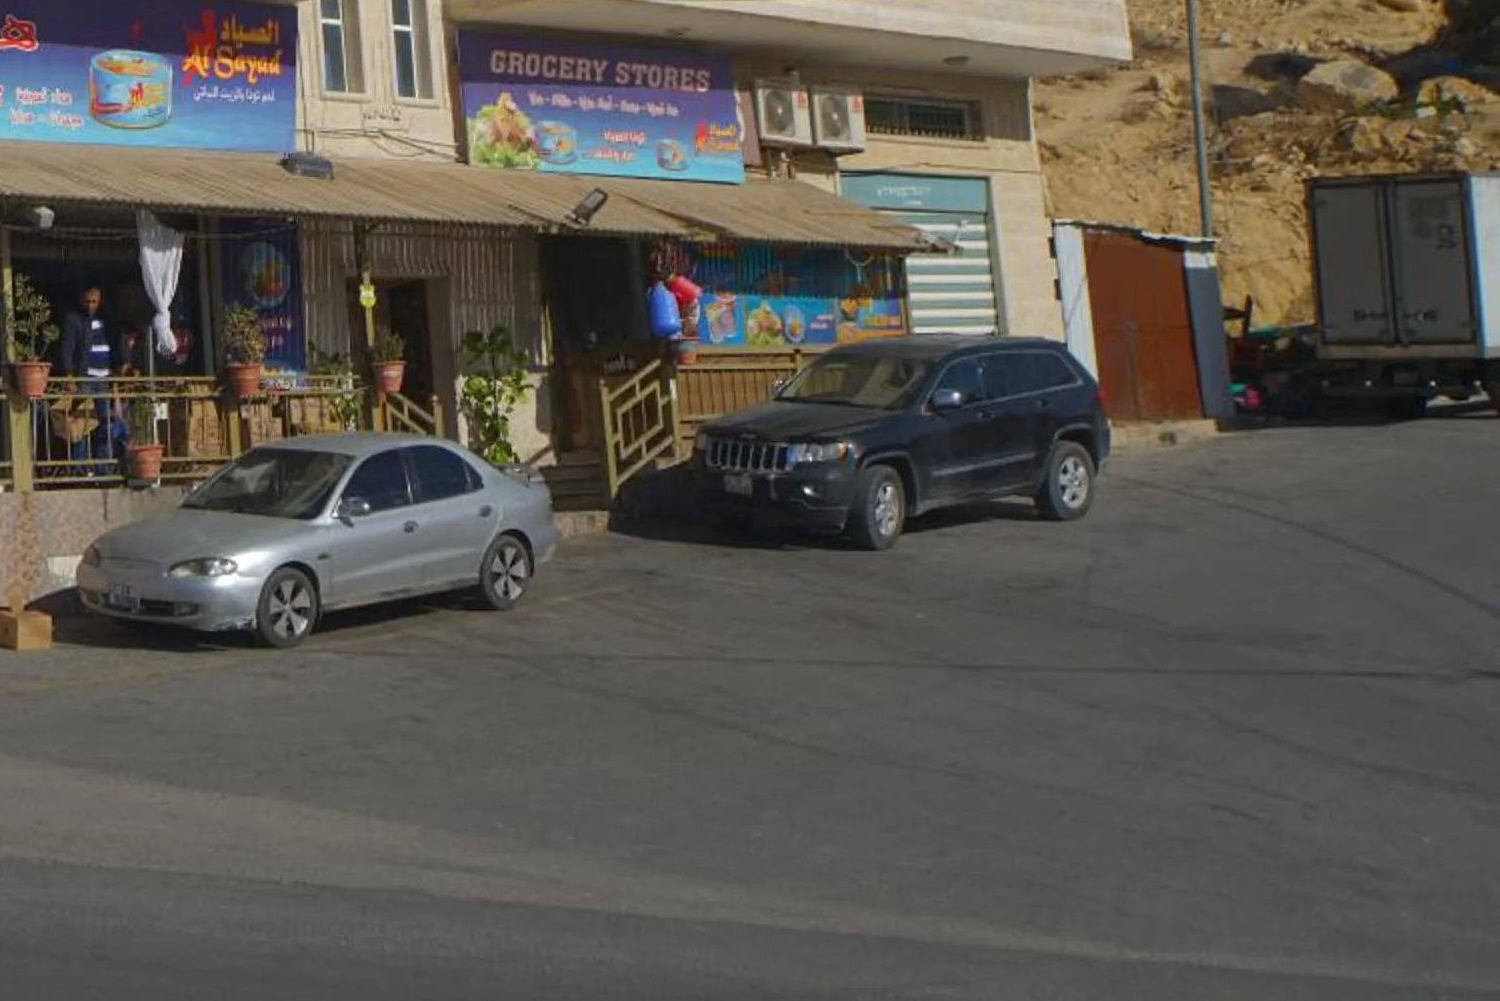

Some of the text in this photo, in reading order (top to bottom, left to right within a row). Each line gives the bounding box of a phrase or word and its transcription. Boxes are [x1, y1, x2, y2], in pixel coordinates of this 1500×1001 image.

[182, 44, 211, 80] Al
[489, 49, 711, 93] GROCERY STORES
